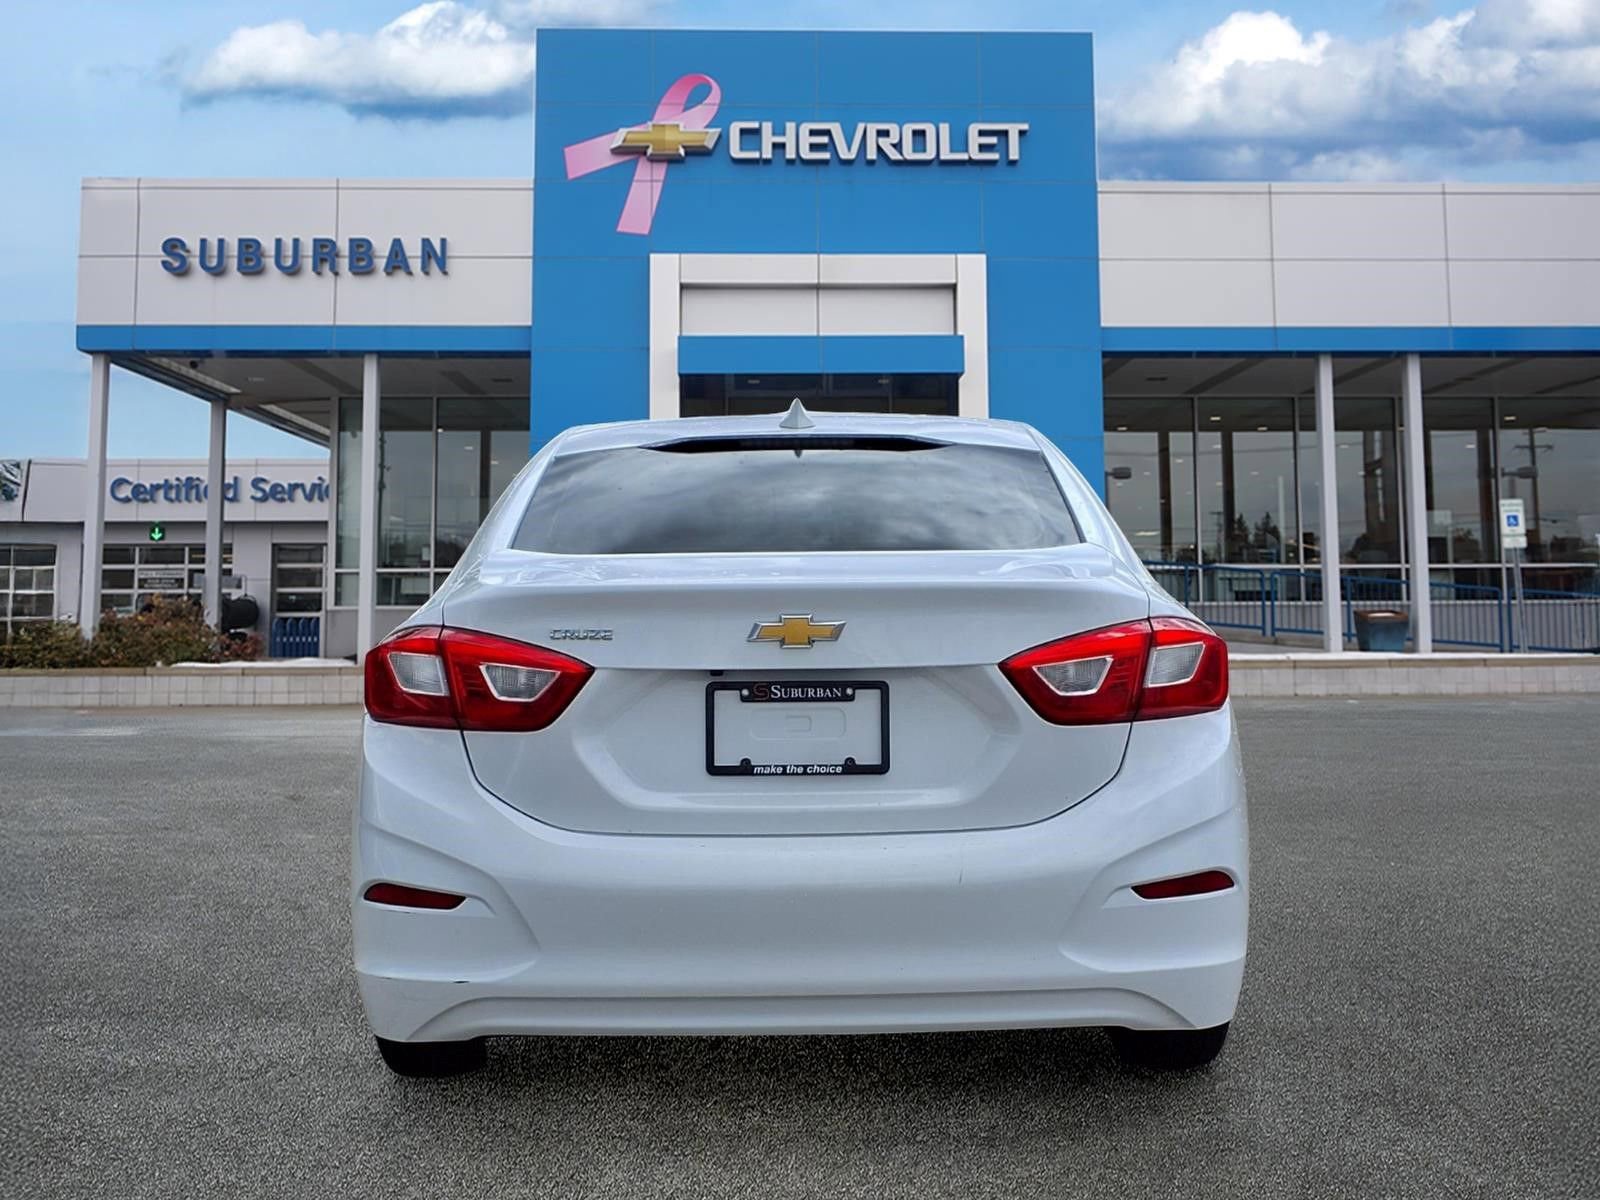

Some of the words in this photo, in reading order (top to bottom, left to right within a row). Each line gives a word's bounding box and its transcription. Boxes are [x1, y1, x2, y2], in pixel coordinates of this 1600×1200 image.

[729, 121, 1029, 161] CHEVROLET
[161, 237, 449, 275] SUBURBAN
[549, 629, 614, 641] CRUZE
[771, 685, 841, 699] SUBURBAN
[753, 764, 783, 774] make
[786, 764, 803, 774] the
[806, 764, 842, 774] choice
